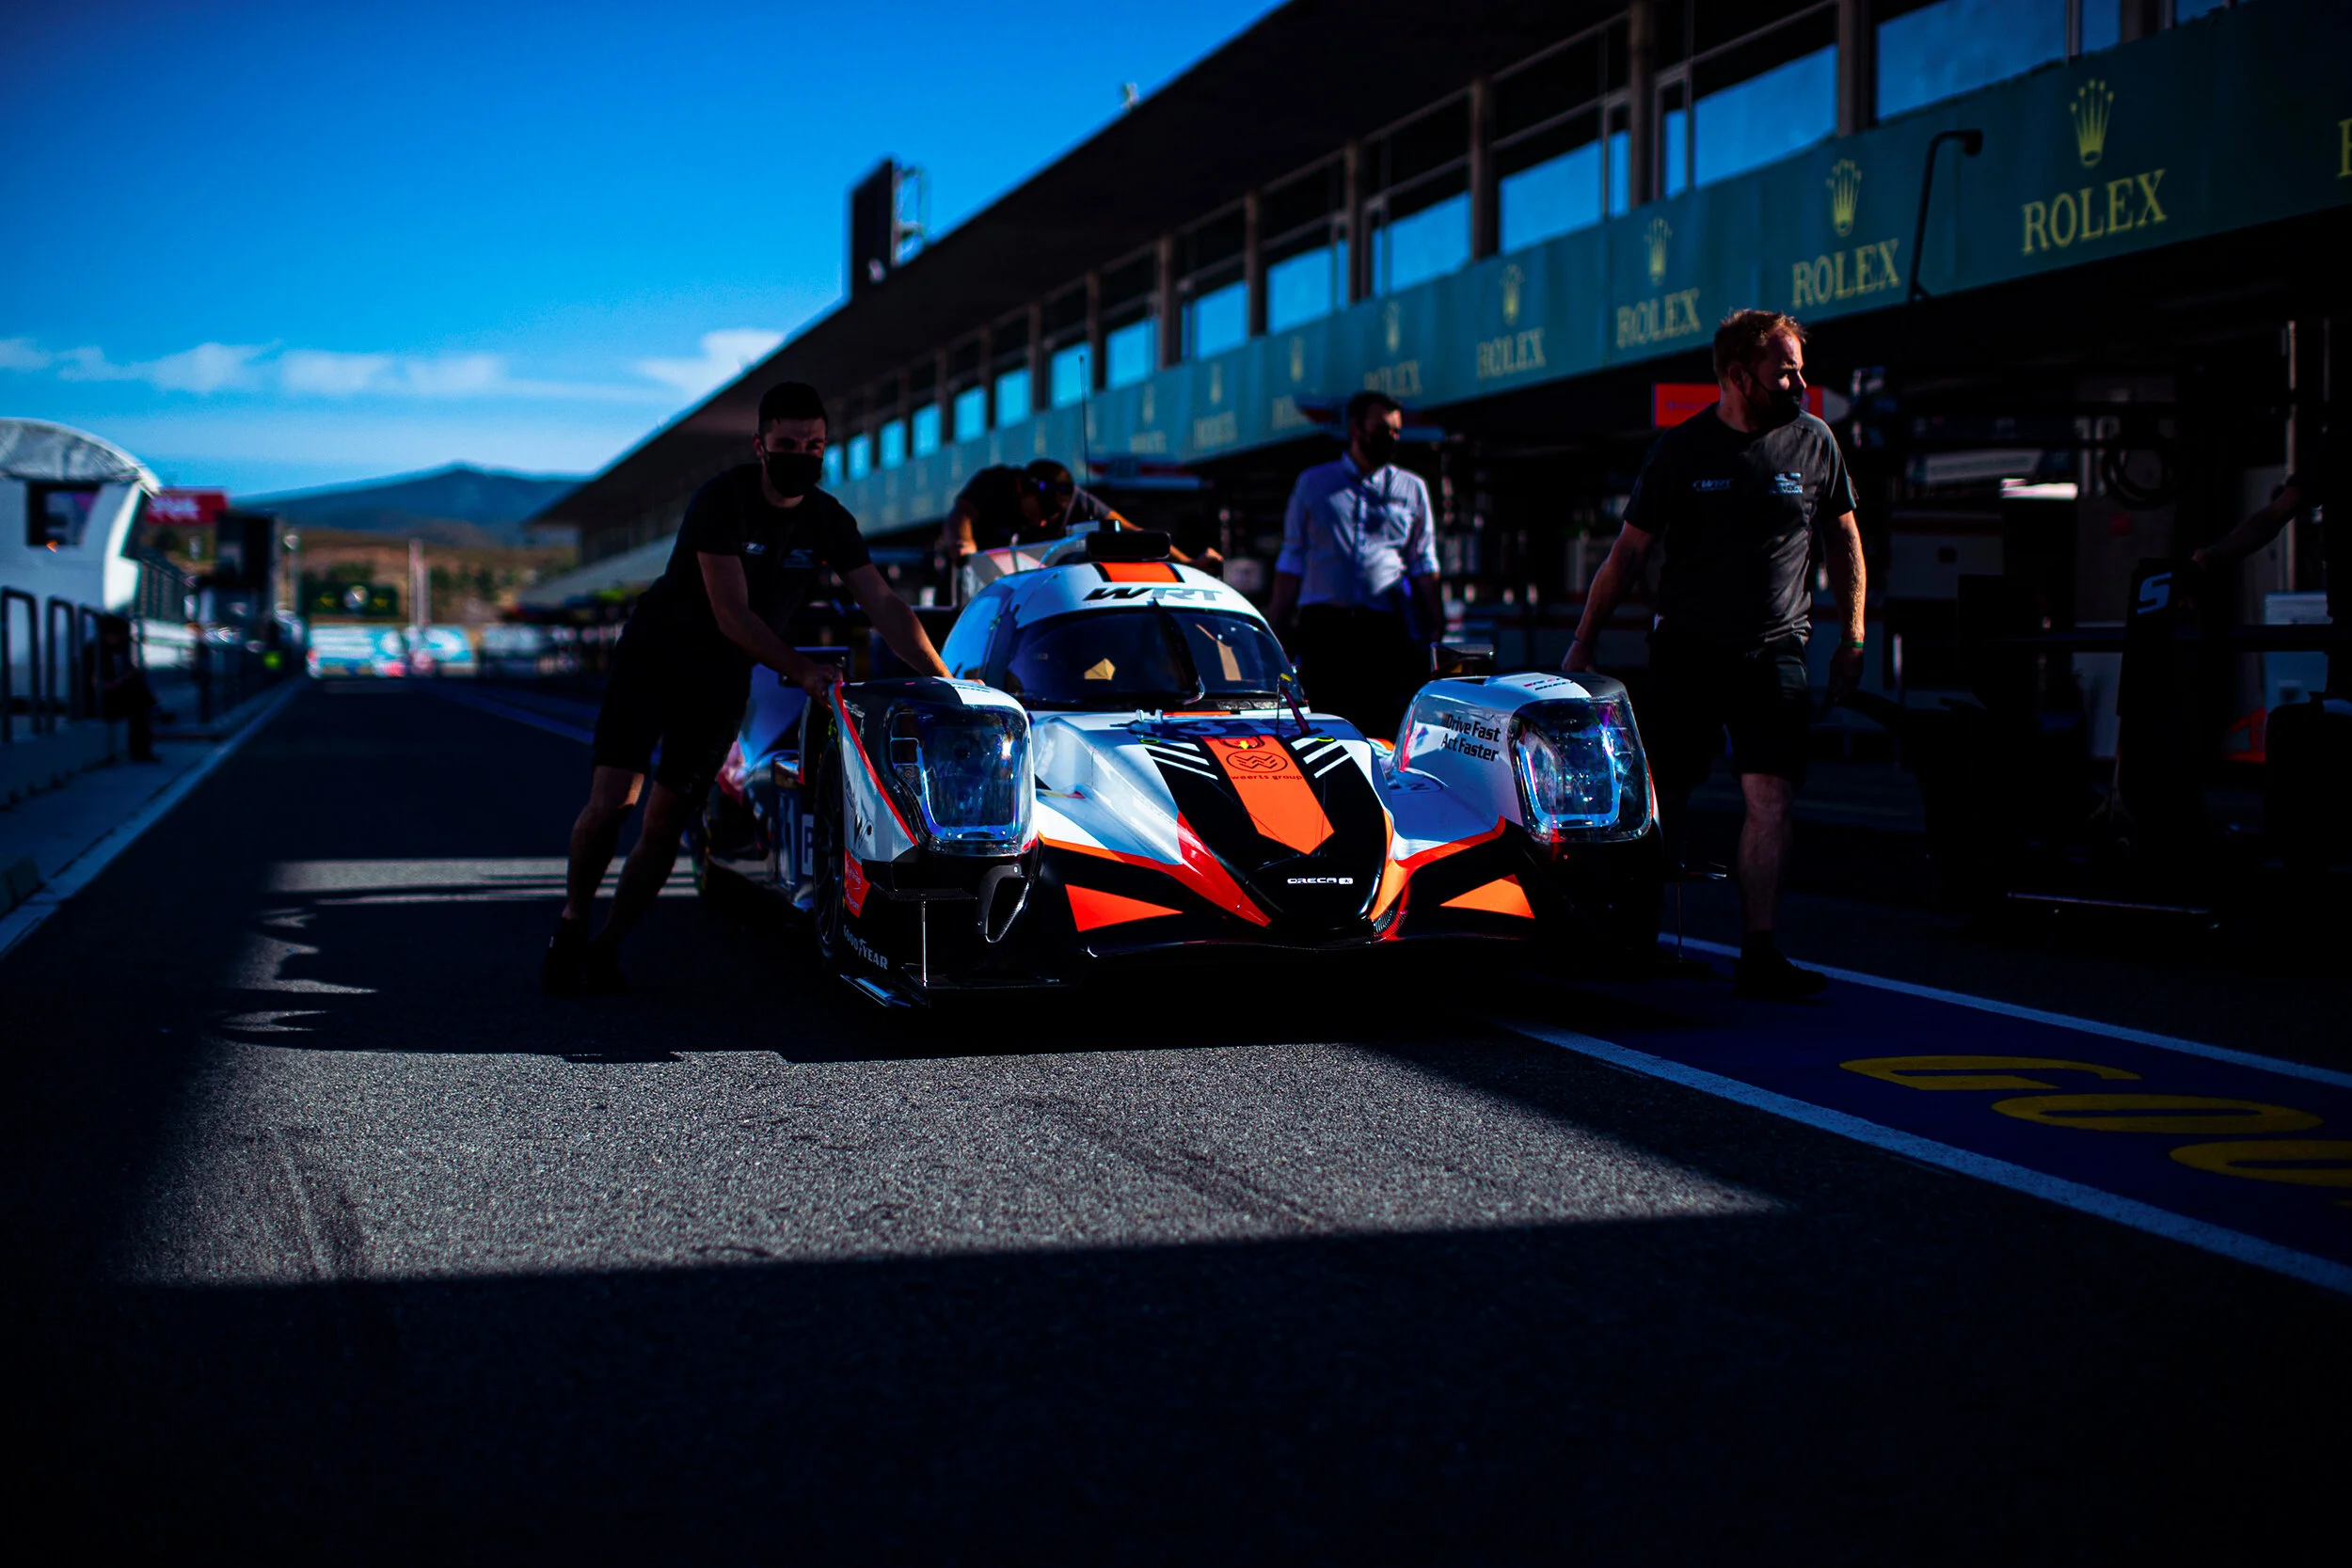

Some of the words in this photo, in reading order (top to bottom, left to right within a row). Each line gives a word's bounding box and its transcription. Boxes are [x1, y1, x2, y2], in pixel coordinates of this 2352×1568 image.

[2021, 167, 2168, 257] ROLEX
[1790, 237, 1901, 309] ROLEX
[1615, 286, 1703, 350] ROLEX
[1082, 586, 1222, 601] WRT
[1440, 733, 1458, 752] Act
[1457, 737, 1500, 762] Faster
[1444, 713, 1471, 735] Drive
[1471, 721, 1501, 742] Fast
